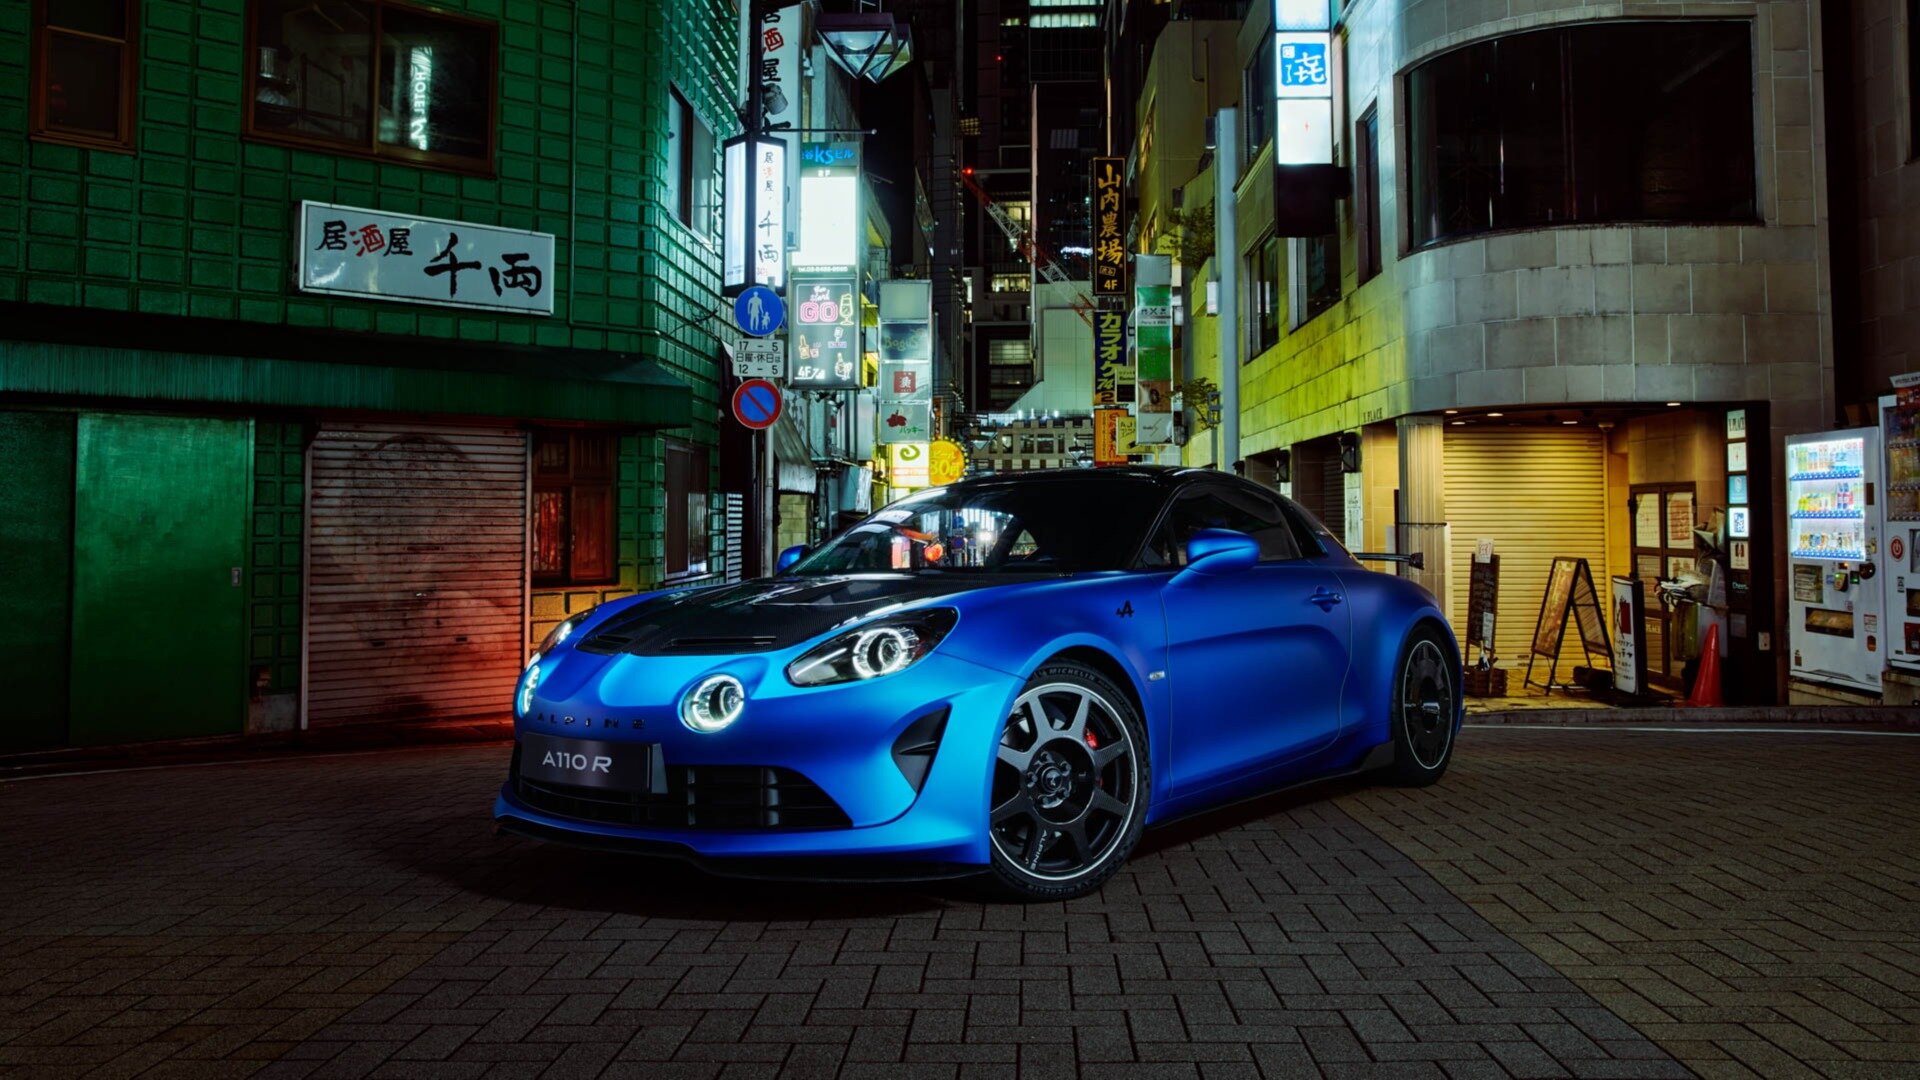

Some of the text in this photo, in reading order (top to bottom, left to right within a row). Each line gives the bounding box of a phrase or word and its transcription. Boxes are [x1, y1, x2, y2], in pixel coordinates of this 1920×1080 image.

[762, 151, 775, 193] 居酒屋
[1097, 163, 1123, 265] 山内農場
[758, 209, 779, 264] 千両
[314, 219, 543, 299] 居酒屋 千両
[1104, 279, 1118, 290] 4F
[800, 301, 839, 323] GO
[739, 341, 749, 351] 17
[772, 342, 779, 352] 5
[1099, 313, 1123, 377] カラオケ
[738, 364, 749, 374] 12
[772, 365, 779, 375] 5
[537, 712, 646, 729] ALPINE
[541, 749, 613, 773] A110 R
[1030, 828, 1048, 871] ALPINE
